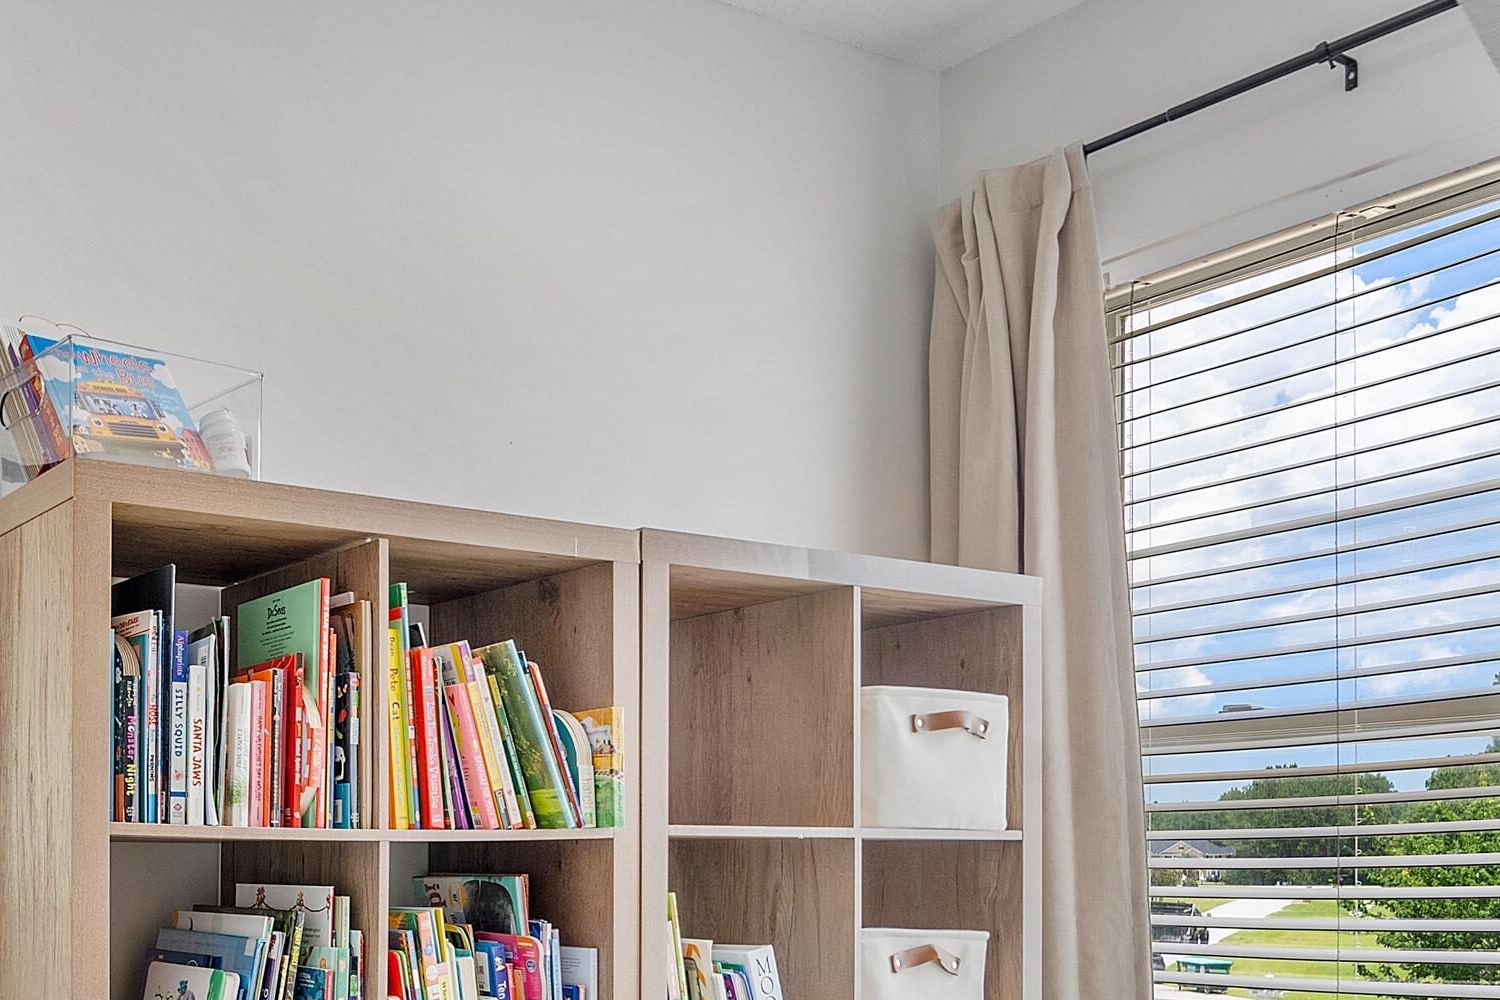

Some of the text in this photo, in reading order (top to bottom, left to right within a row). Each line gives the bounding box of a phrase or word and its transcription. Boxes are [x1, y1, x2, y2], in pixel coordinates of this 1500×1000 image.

[389, 668, 400, 721] Pete Cat
[125, 714, 137, 761] Monster
[174, 688, 183, 758] SILLY SQUID
[192, 717, 203, 753] SANTA
[125, 763, 137, 796] Night
[192, 755, 203, 787] JAWS
[497, 980, 507, 999] Ten
